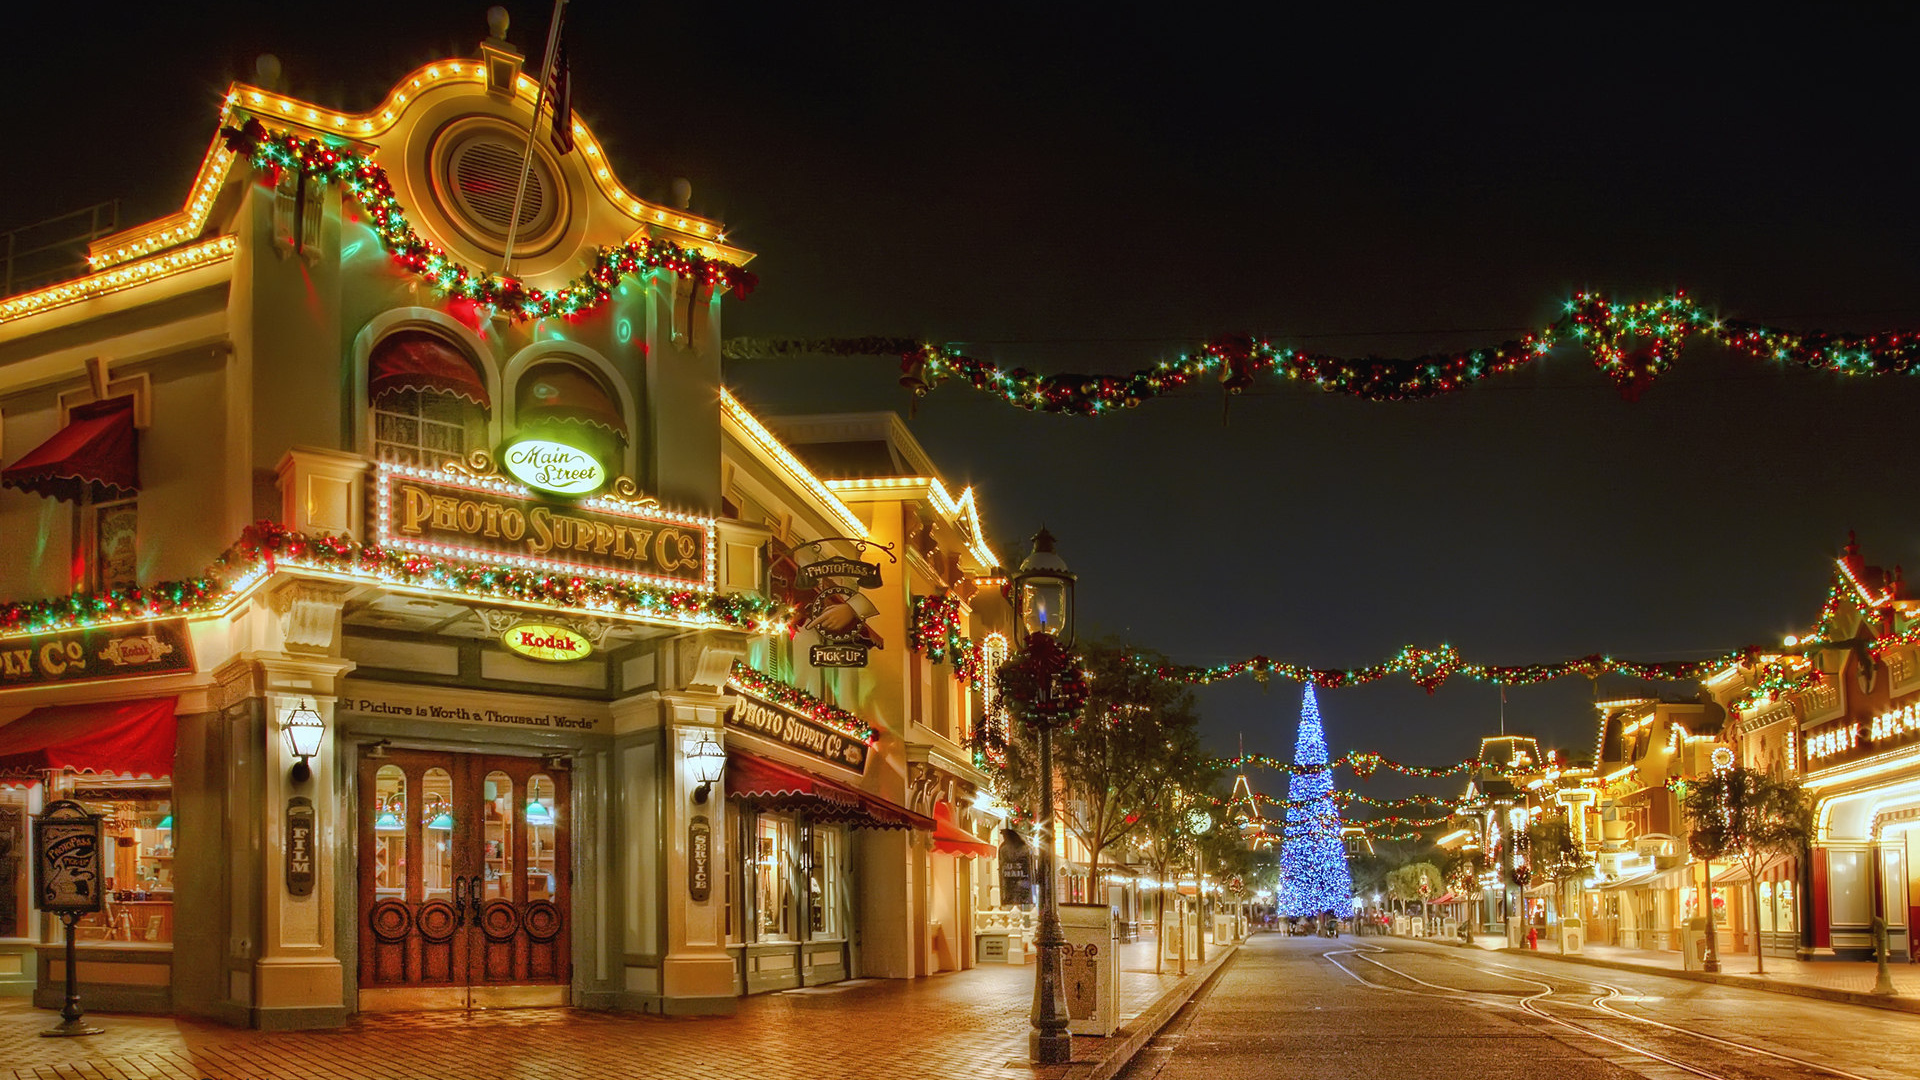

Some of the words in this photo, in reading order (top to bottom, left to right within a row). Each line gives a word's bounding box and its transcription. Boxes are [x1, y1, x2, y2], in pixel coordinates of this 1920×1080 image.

[511, 445, 584, 468] Main
[536, 464, 596, 487] Street
[402, 484, 526, 541] PHOTO
[527, 507, 653, 560] SUPPLY
[520, 631, 576, 651] Kodak
[816, 650, 861, 662] PICK-UP
[360, 699, 413, 715] Picture
[416, 705, 427, 717] is
[429, 705, 471, 720] Worth
[472, 712, 483, 721] a
[485, 710, 550, 726] Thousand
[732, 694, 783, 734] PHOTO
[783, 716, 827, 752] SUPPLY
[1807, 723, 1859, 760] PENNY
[292, 827, 310, 873] FILM
[694, 834, 707, 889] SERVICE
